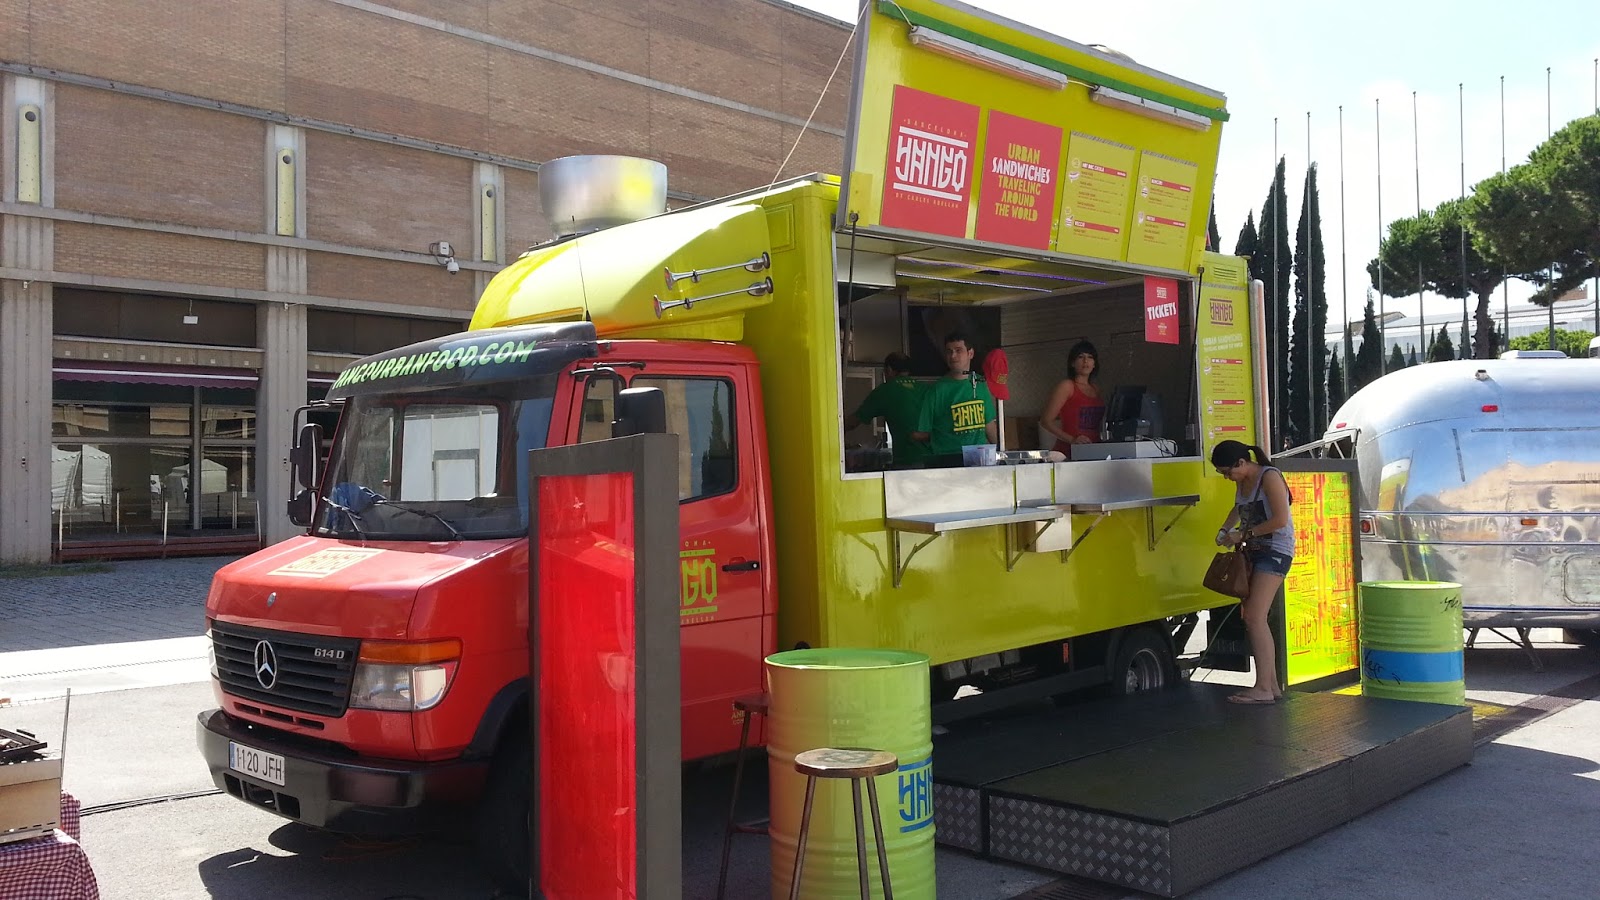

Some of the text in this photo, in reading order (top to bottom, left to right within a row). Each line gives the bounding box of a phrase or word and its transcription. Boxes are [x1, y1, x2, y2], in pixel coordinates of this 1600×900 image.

[1007, 142, 1041, 165] URBAN
[991, 156, 1051, 184] SANDWICHES
[998, 174, 1042, 196] TRAVELING
[1001, 189, 1035, 208] AROUND
[995, 202, 1039, 222] THE WORLD
[1147, 301, 1177, 321] TICKETS
[314, 647, 345, 659] 614 D
[236, 747, 282, 781] 1120 JFH
